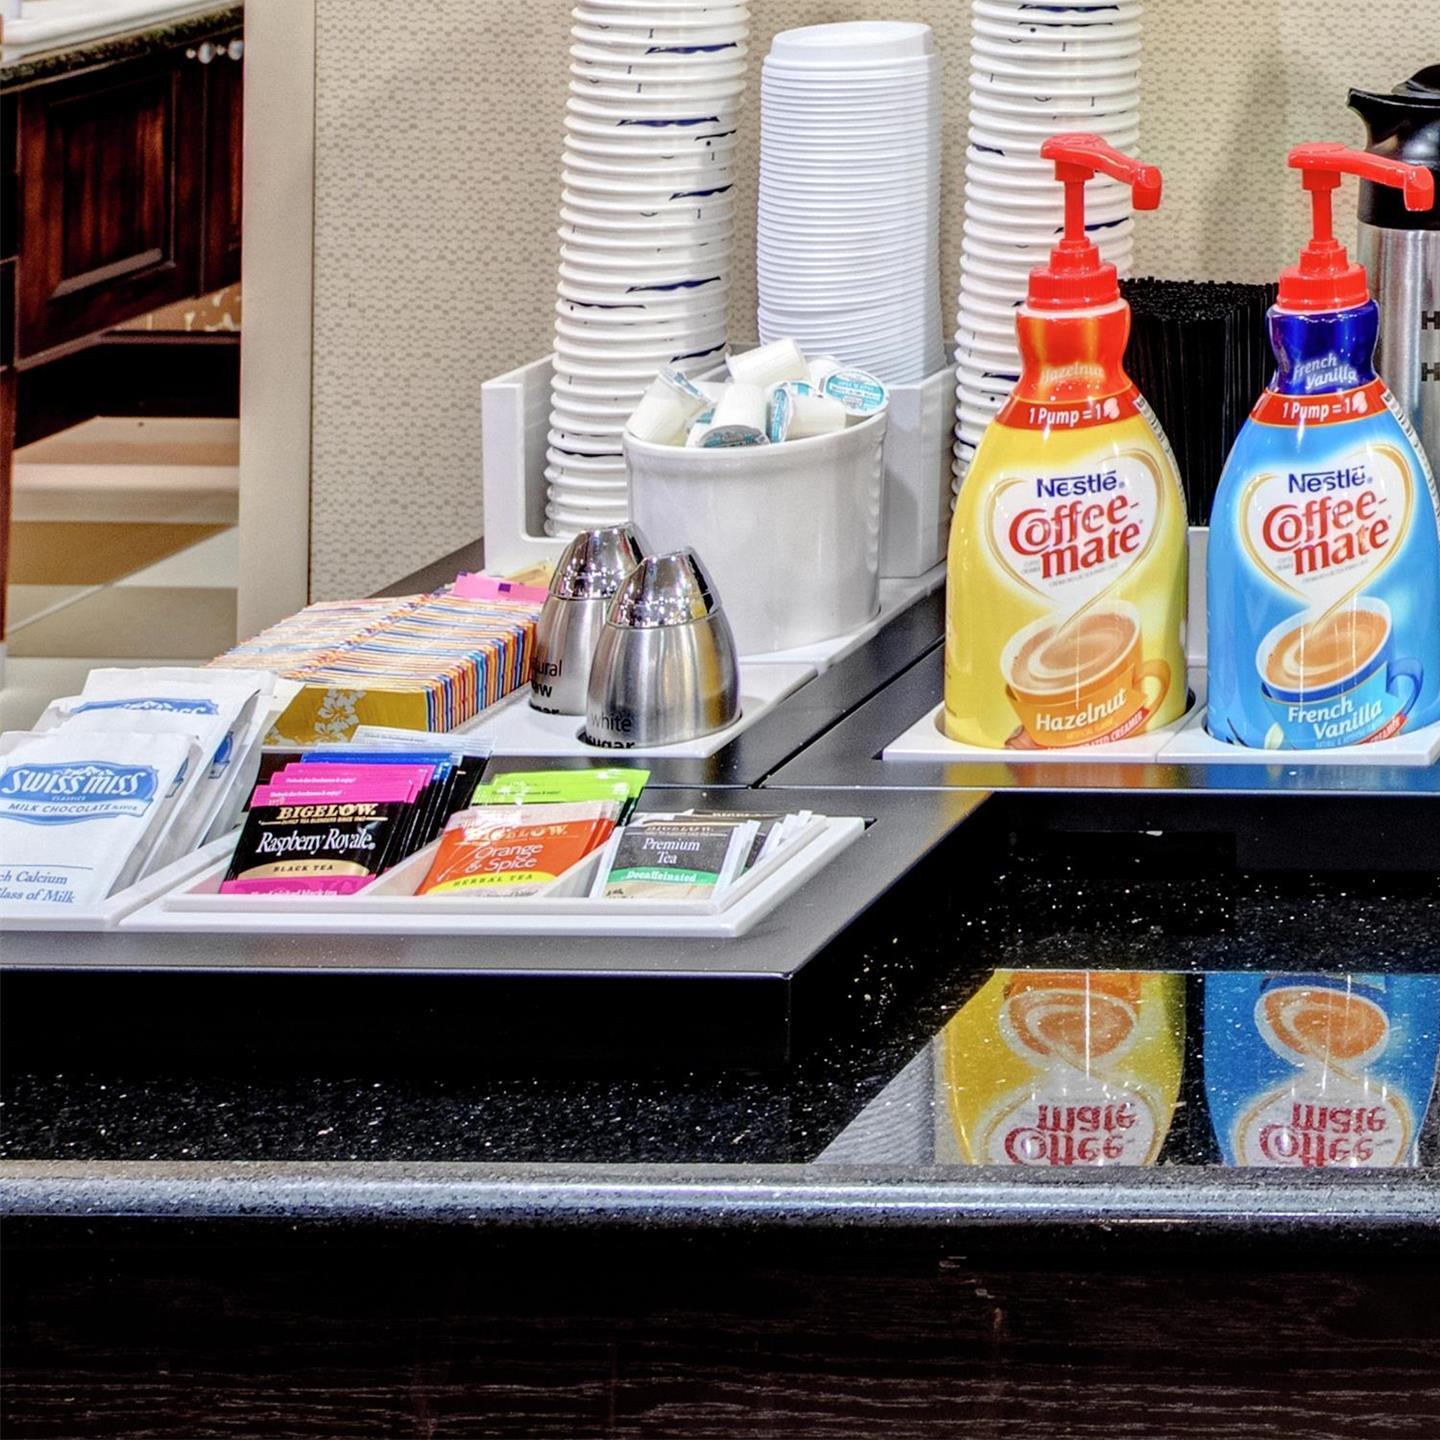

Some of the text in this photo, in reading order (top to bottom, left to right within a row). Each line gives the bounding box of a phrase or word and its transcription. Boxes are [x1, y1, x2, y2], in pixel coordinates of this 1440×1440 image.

[1292, 353, 1338, 381] French
[1304, 364, 1358, 390] Vanilla
[1029, 408, 1035, 424] 1
[1038, 408, 1080, 427] Pump
[1282, 403, 1288, 419] 1
[1290, 402, 1329, 421] Pump
[1040, 521, 1141, 579] mate
[1293, 518, 1390, 576] mate
[1035, 687, 1127, 731] Hazelnut
[1288, 696, 1354, 723] French
[591, 711, 632, 732] white
[1313, 699, 1383, 740] Vanilla
[8, 803, 40, 812] MILK
[42, 802, 115, 813] CHOCOLATE
[256, 829, 327, 856] Raspberry
[643, 837, 700, 852] Premium
[474, 844, 544, 861] Orange
[656, 851, 677, 864] Tea
[273, 864, 308, 872] BLACK
[464, 856, 538, 874] & Spice
[16, 870, 68, 885] Calcium
[453, 873, 533, 886] HERBAL TEA
[626, 870, 698, 882] Decaffeinated
[0, 887, 76, 903] lass of Milk
